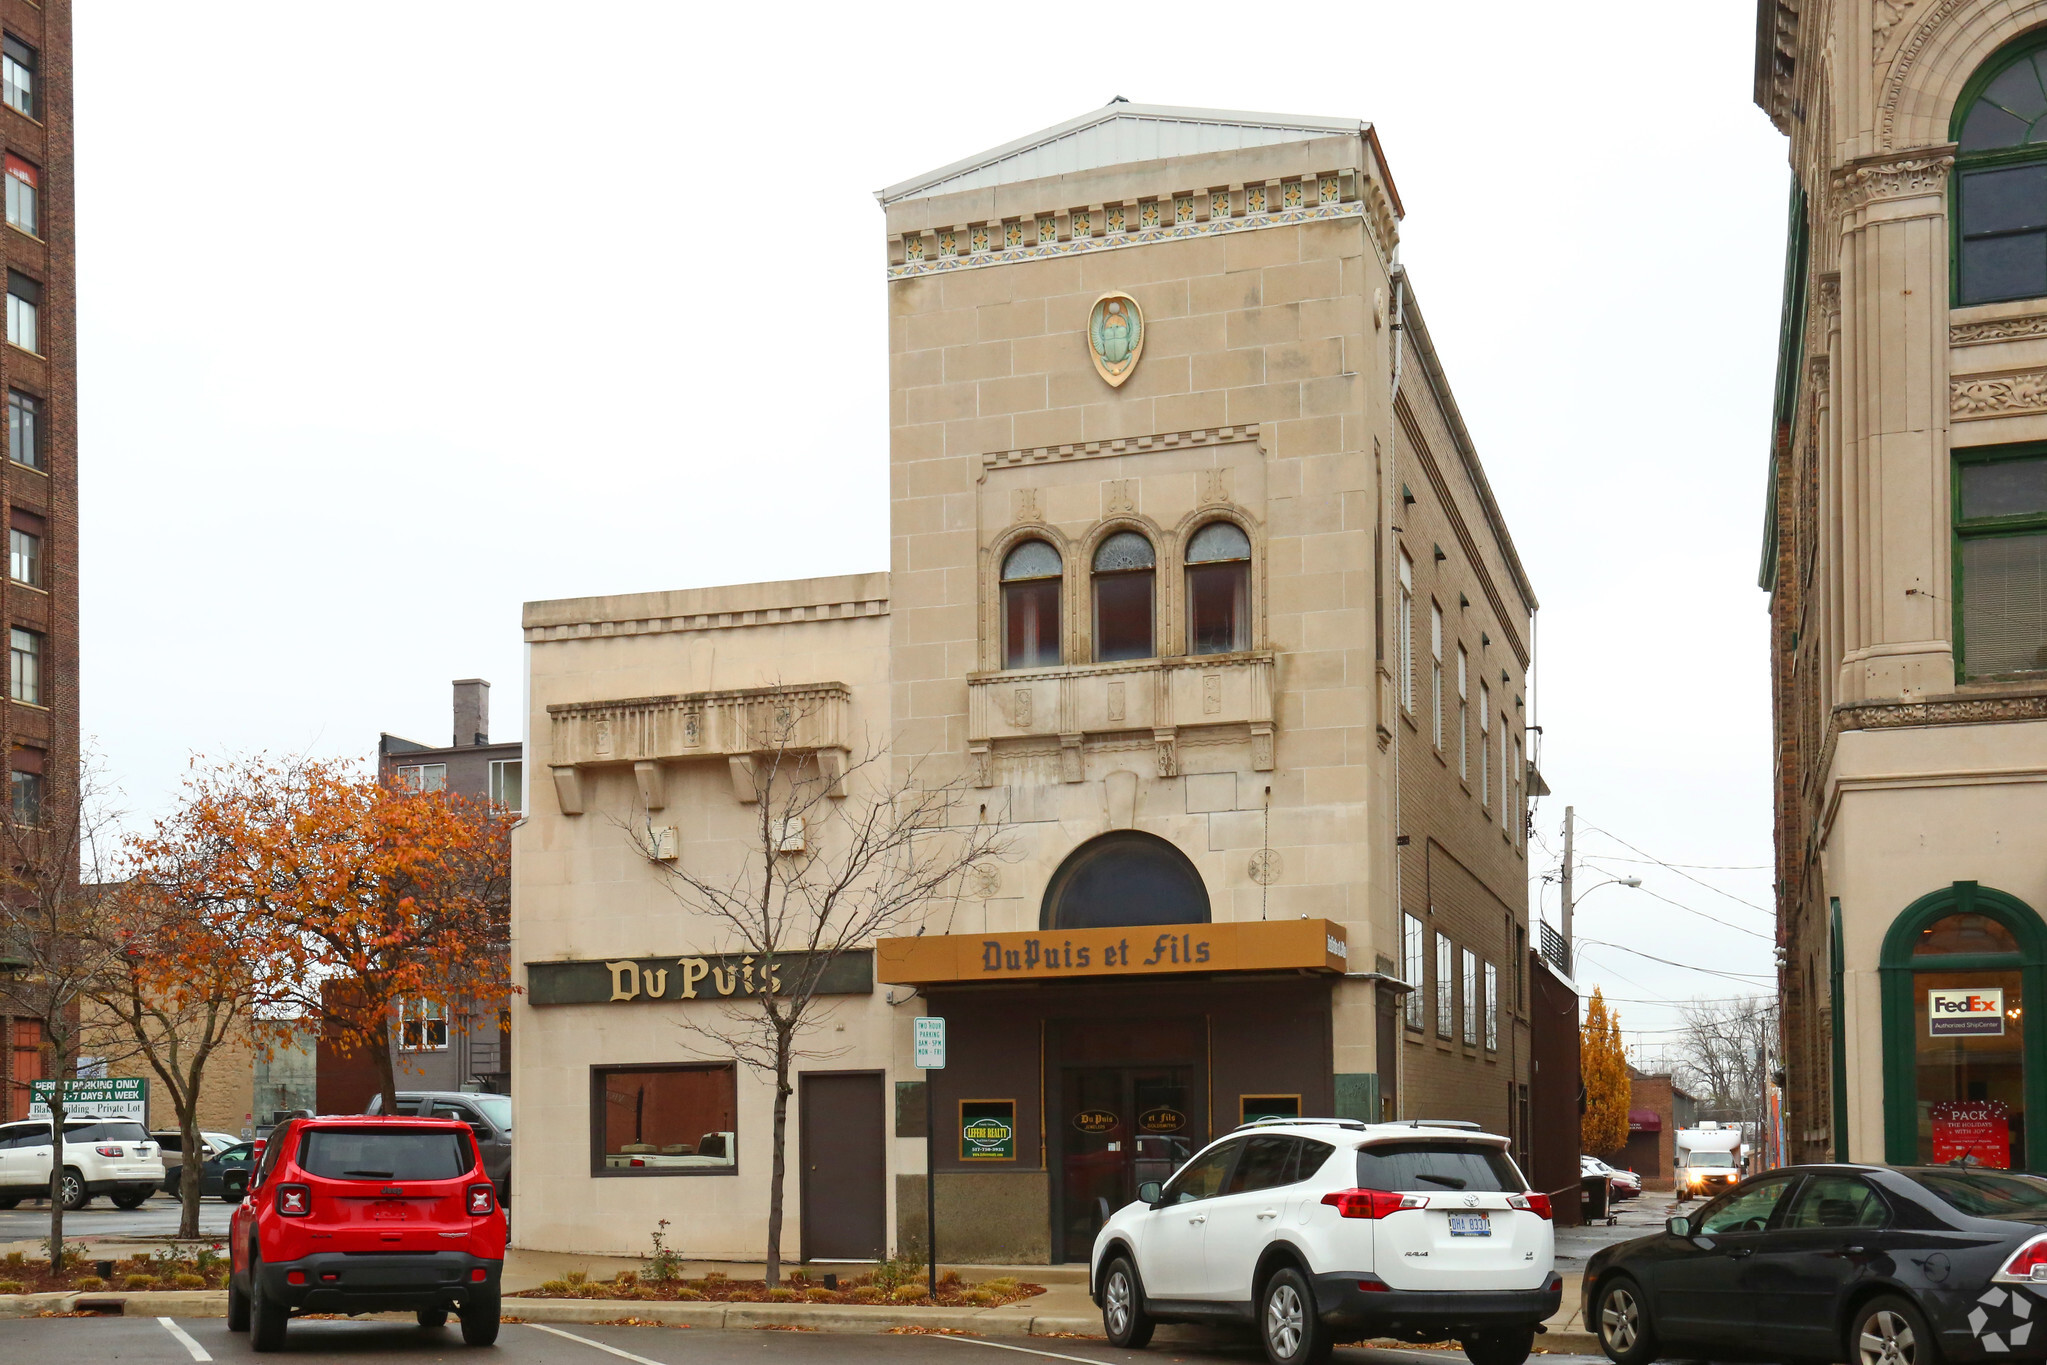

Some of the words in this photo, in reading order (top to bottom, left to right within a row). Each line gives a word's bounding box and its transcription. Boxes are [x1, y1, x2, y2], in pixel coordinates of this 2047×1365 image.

[982, 939, 1090, 971] DuPuis
[1104, 938, 1129, 967] et
[1143, 933, 1210, 965] Fils
[605, 960, 669, 1002] Du
[677, 955, 782, 999] Puis
[1935, 995, 1996, 1012] FedEx
[35, 1081, 69, 1090] PERT
[72, 1080, 113, 1090] PARKING
[116, 1079, 140, 1089] ONLY
[81, 1091, 103, 1100] DAYS
[105, 1091, 112, 1100] A
[115, 1090, 139, 1100] WEEK
[34, 1104, 52, 1114] Blak
[63, 1104, 90, 1115] uilding
[97, 1103, 124, 1113] Private
[127, 1102, 141, 1112] Lot
[1951, 1110, 1988, 1120] PACK
[987, 1127, 1007, 1138] REALTY
[381, 1186, 403, 1196] Jeep
